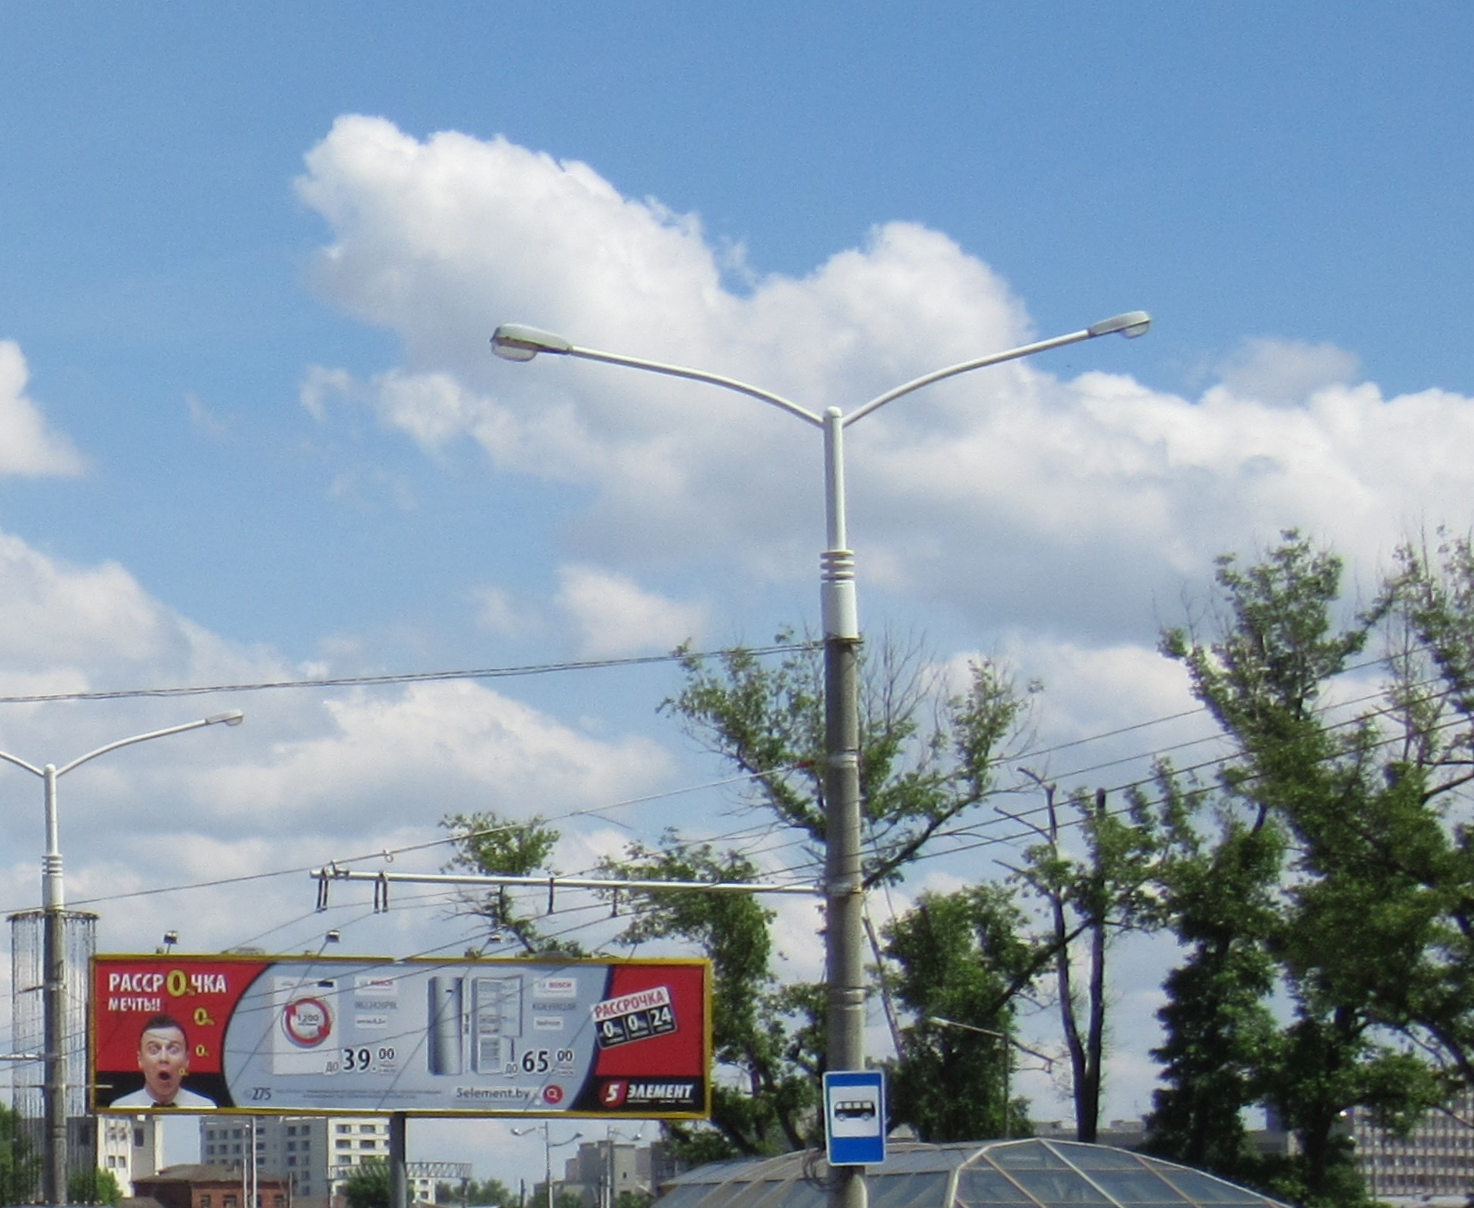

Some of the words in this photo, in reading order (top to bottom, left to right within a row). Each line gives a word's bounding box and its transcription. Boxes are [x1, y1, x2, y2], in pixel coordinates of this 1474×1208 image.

[594, 990, 665, 1018] РАССРОЧКА
[650, 1006, 672, 1027] 24
[378, 1048, 395, 1060] 00
[557, 1050, 573, 1062] 00
[605, 1084, 620, 1102] 5
[627, 1084, 694, 1098] ЭЛЕМЕНТ
